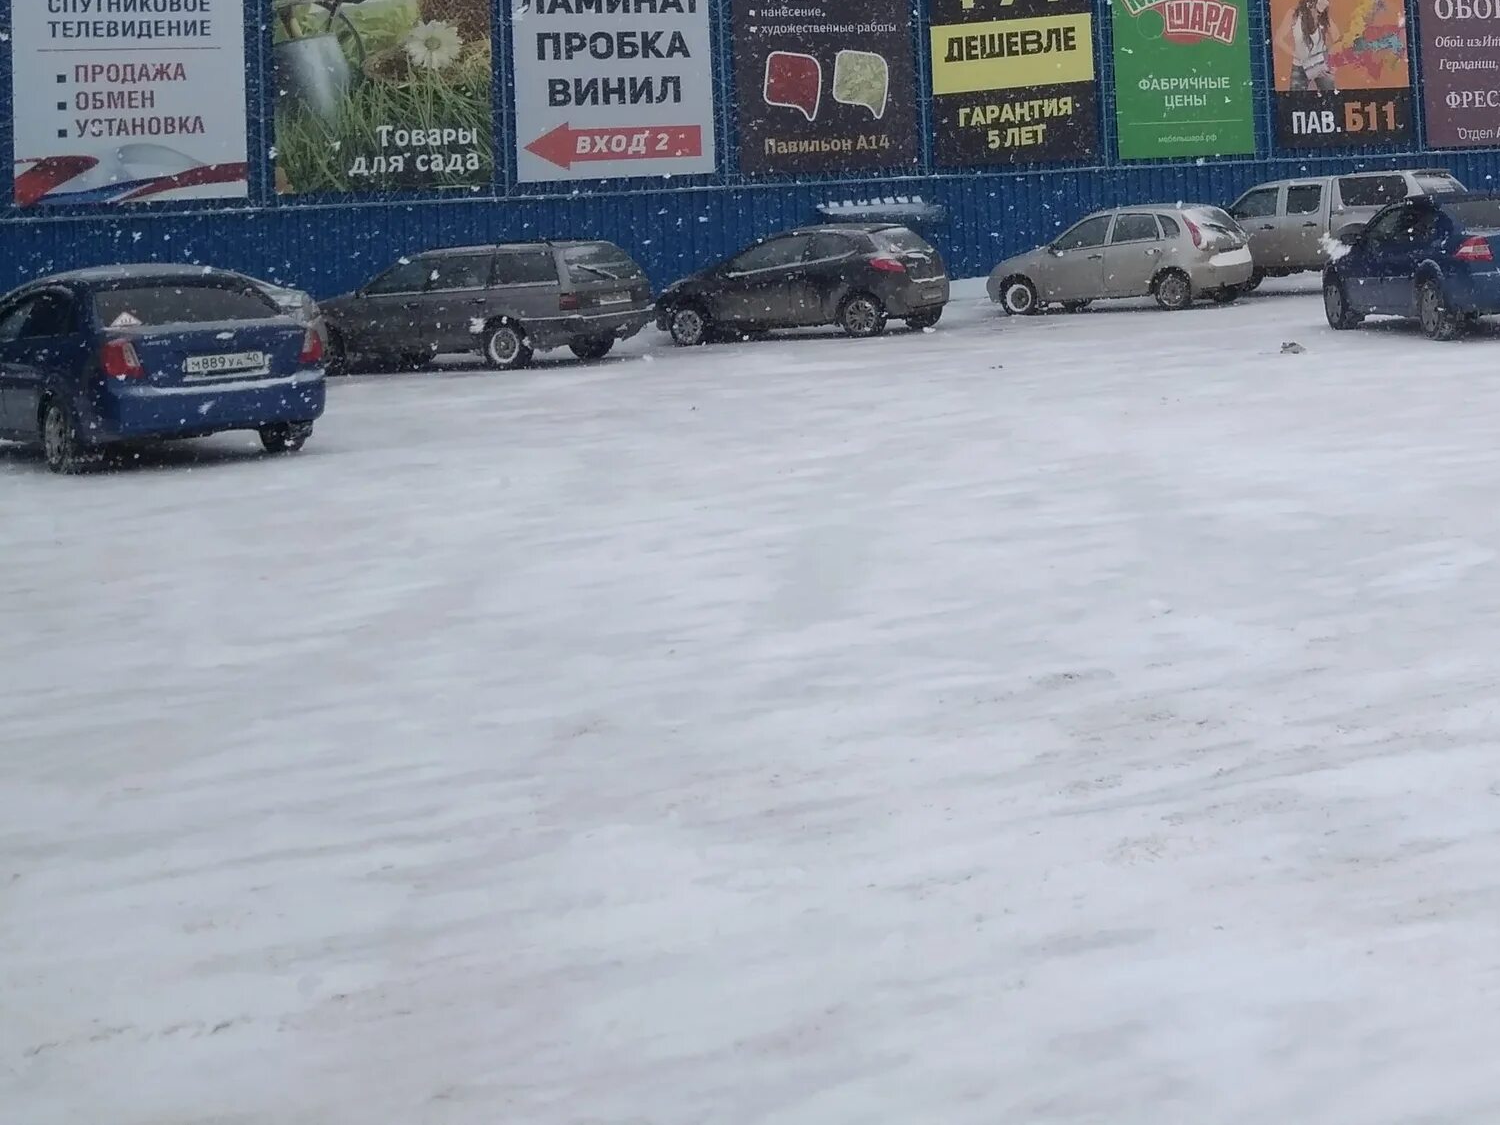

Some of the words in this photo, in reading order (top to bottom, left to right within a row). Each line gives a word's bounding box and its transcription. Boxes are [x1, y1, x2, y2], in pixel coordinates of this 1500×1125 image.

[761, 7, 821, 17] нанесение
[1166, 0, 1236, 42] ШАРА
[48, 20, 211, 39] ТЕЛЕВИДЕНИЕ
[761, 23, 854, 35] художественные
[857, 22, 896, 34] работы
[536, 31, 691, 61] ПРОБКА
[944, 27, 1076, 63] ДЕШЕВЛЕ
[1435, 36, 1464, 48] Обои
[74, 63, 186, 84] ПРОДАЖА
[1138, 77, 1230, 90] ФАБРИЧНЫЕ
[75, 90, 155, 110] ОБМЕН
[548, 76, 682, 107] ВИНИЛ
[1164, 94, 1207, 108] ЦЕНЫ
[959, 97, 1072, 127] ГАРАНТИЯ
[1292, 111, 1341, 134] ПАВ.
[1344, 101, 1396, 132] Б11
[76, 116, 205, 138] УСТАНОВКА
[376, 125, 478, 147] Товары
[988, 131, 1000, 149] 5
[1004, 124, 1047, 148] ЛЕТ
[1458, 127, 1492, 141] Отдел
[576, 133, 647, 155] ВХОД
[655, 133, 669, 151] 2
[765, 138, 851, 155] Павильон
[857, 134, 890, 151] А14
[349, 155, 405, 176] для
[415, 152, 479, 174] сада
